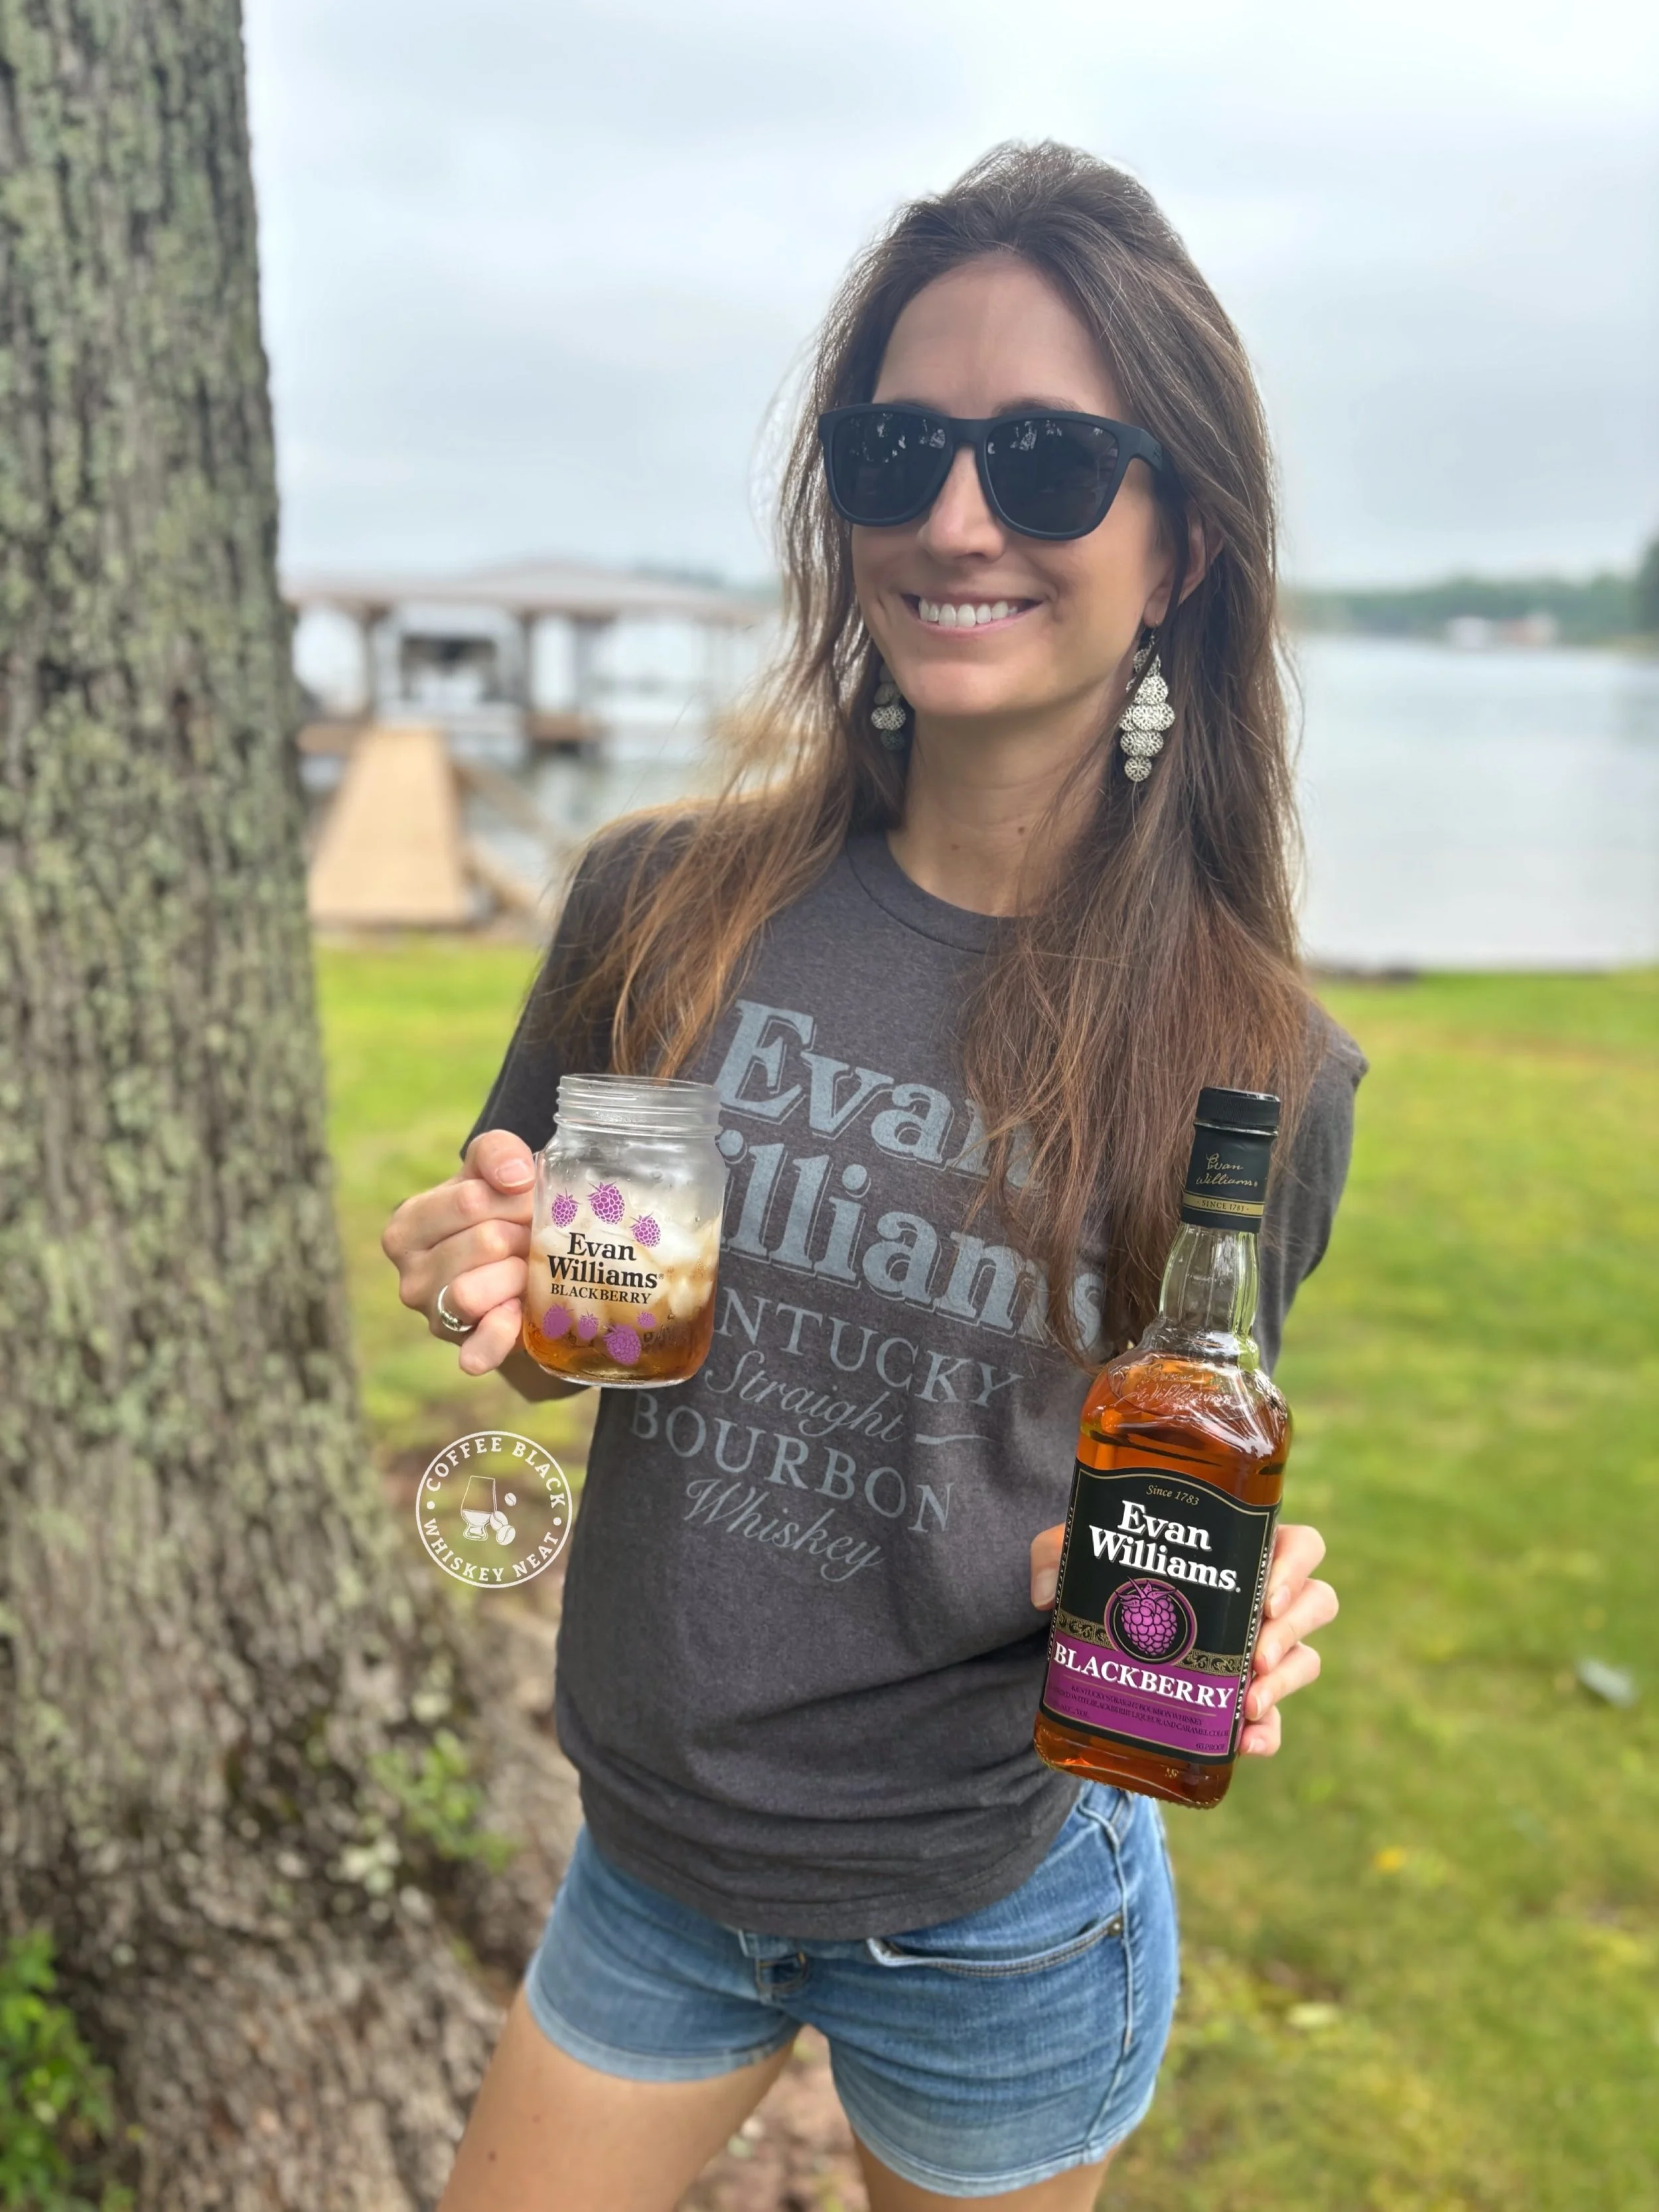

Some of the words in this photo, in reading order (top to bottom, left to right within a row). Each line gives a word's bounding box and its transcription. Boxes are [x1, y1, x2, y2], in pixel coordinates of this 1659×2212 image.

[1206, 1152, 1244, 1171] Evan
[1202, 1199, 1227, 1210] SINCE
[1229, 1203, 1244, 1213] 1783
[567, 1232, 637, 1262] Evan
[718, 1128, 1106, 1354] lliams
[550, 1283, 652, 1305] BLACKBERRY
[714, 1287, 1026, 1408] NTUCKY
[704, 1350, 906, 1443] Straight
[631, 1391, 956, 1534] BOURBON
[1146, 1484, 1173, 1499] Since
[1175, 1491, 1200, 1507] 1783
[685, 1477, 885, 1582] Whiskey
[1118, 1499, 1212, 1551] Evan
[1053, 1641, 1234, 1710] BLACKBERRY
[1234, 1688, 1245, 1720] MADE
[1241, 1651, 1251, 1682] WITH
[1248, 1617, 1257, 1647] EVAN
